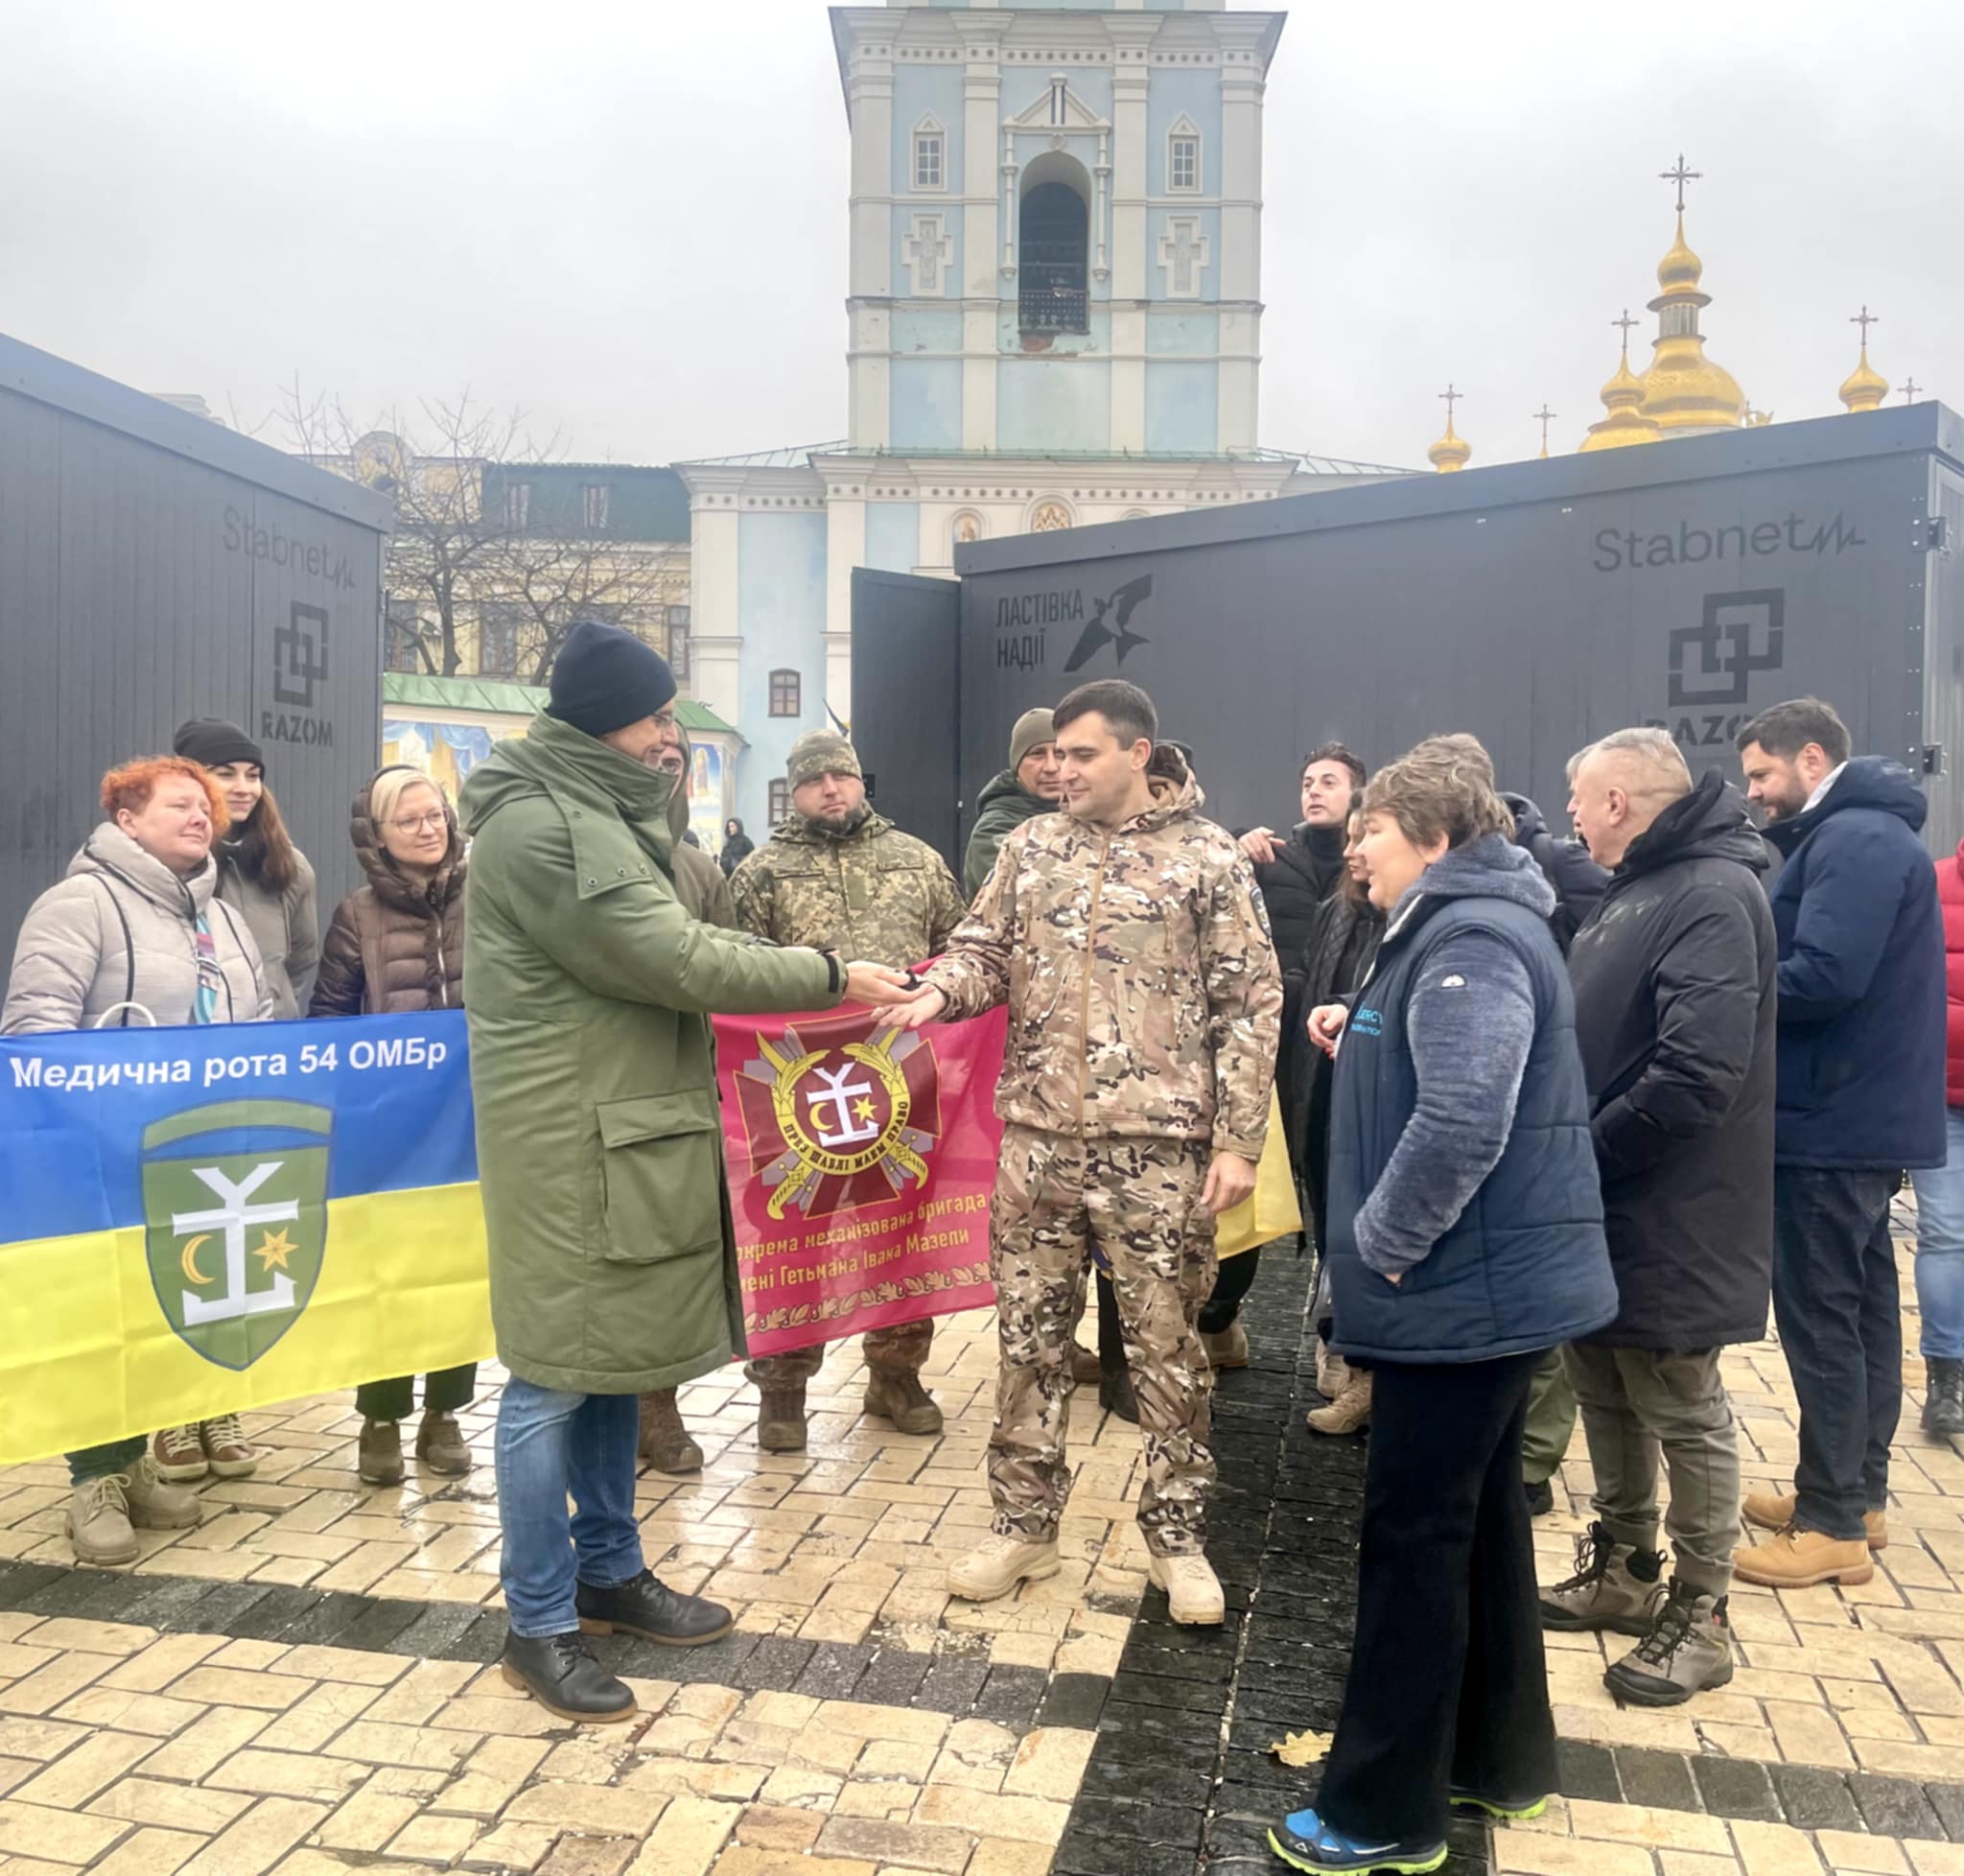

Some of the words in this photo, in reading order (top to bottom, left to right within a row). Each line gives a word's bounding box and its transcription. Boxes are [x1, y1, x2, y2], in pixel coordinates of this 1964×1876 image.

[222, 504, 332, 580] Stabnet
[1592, 513, 1807, 573] Stabnet
[996, 589, 1084, 627] ЛАСТІВКА
[996, 627, 1046, 670] НАДІЇ
[261, 711, 334, 747] RAZOM
[12, 1056, 191, 1090] Медична
[204, 1052, 288, 1086] рота
[299, 1044, 338, 1073] 54
[349, 1037, 447, 1069] ОМБр
[805, 1210, 914, 1249] механізована
[918, 1193, 986, 1224] бригада
[781, 1257, 858, 1286] Гетьмана
[863, 1244, 901, 1270] Івана
[905, 1229, 970, 1255] Мазепи
